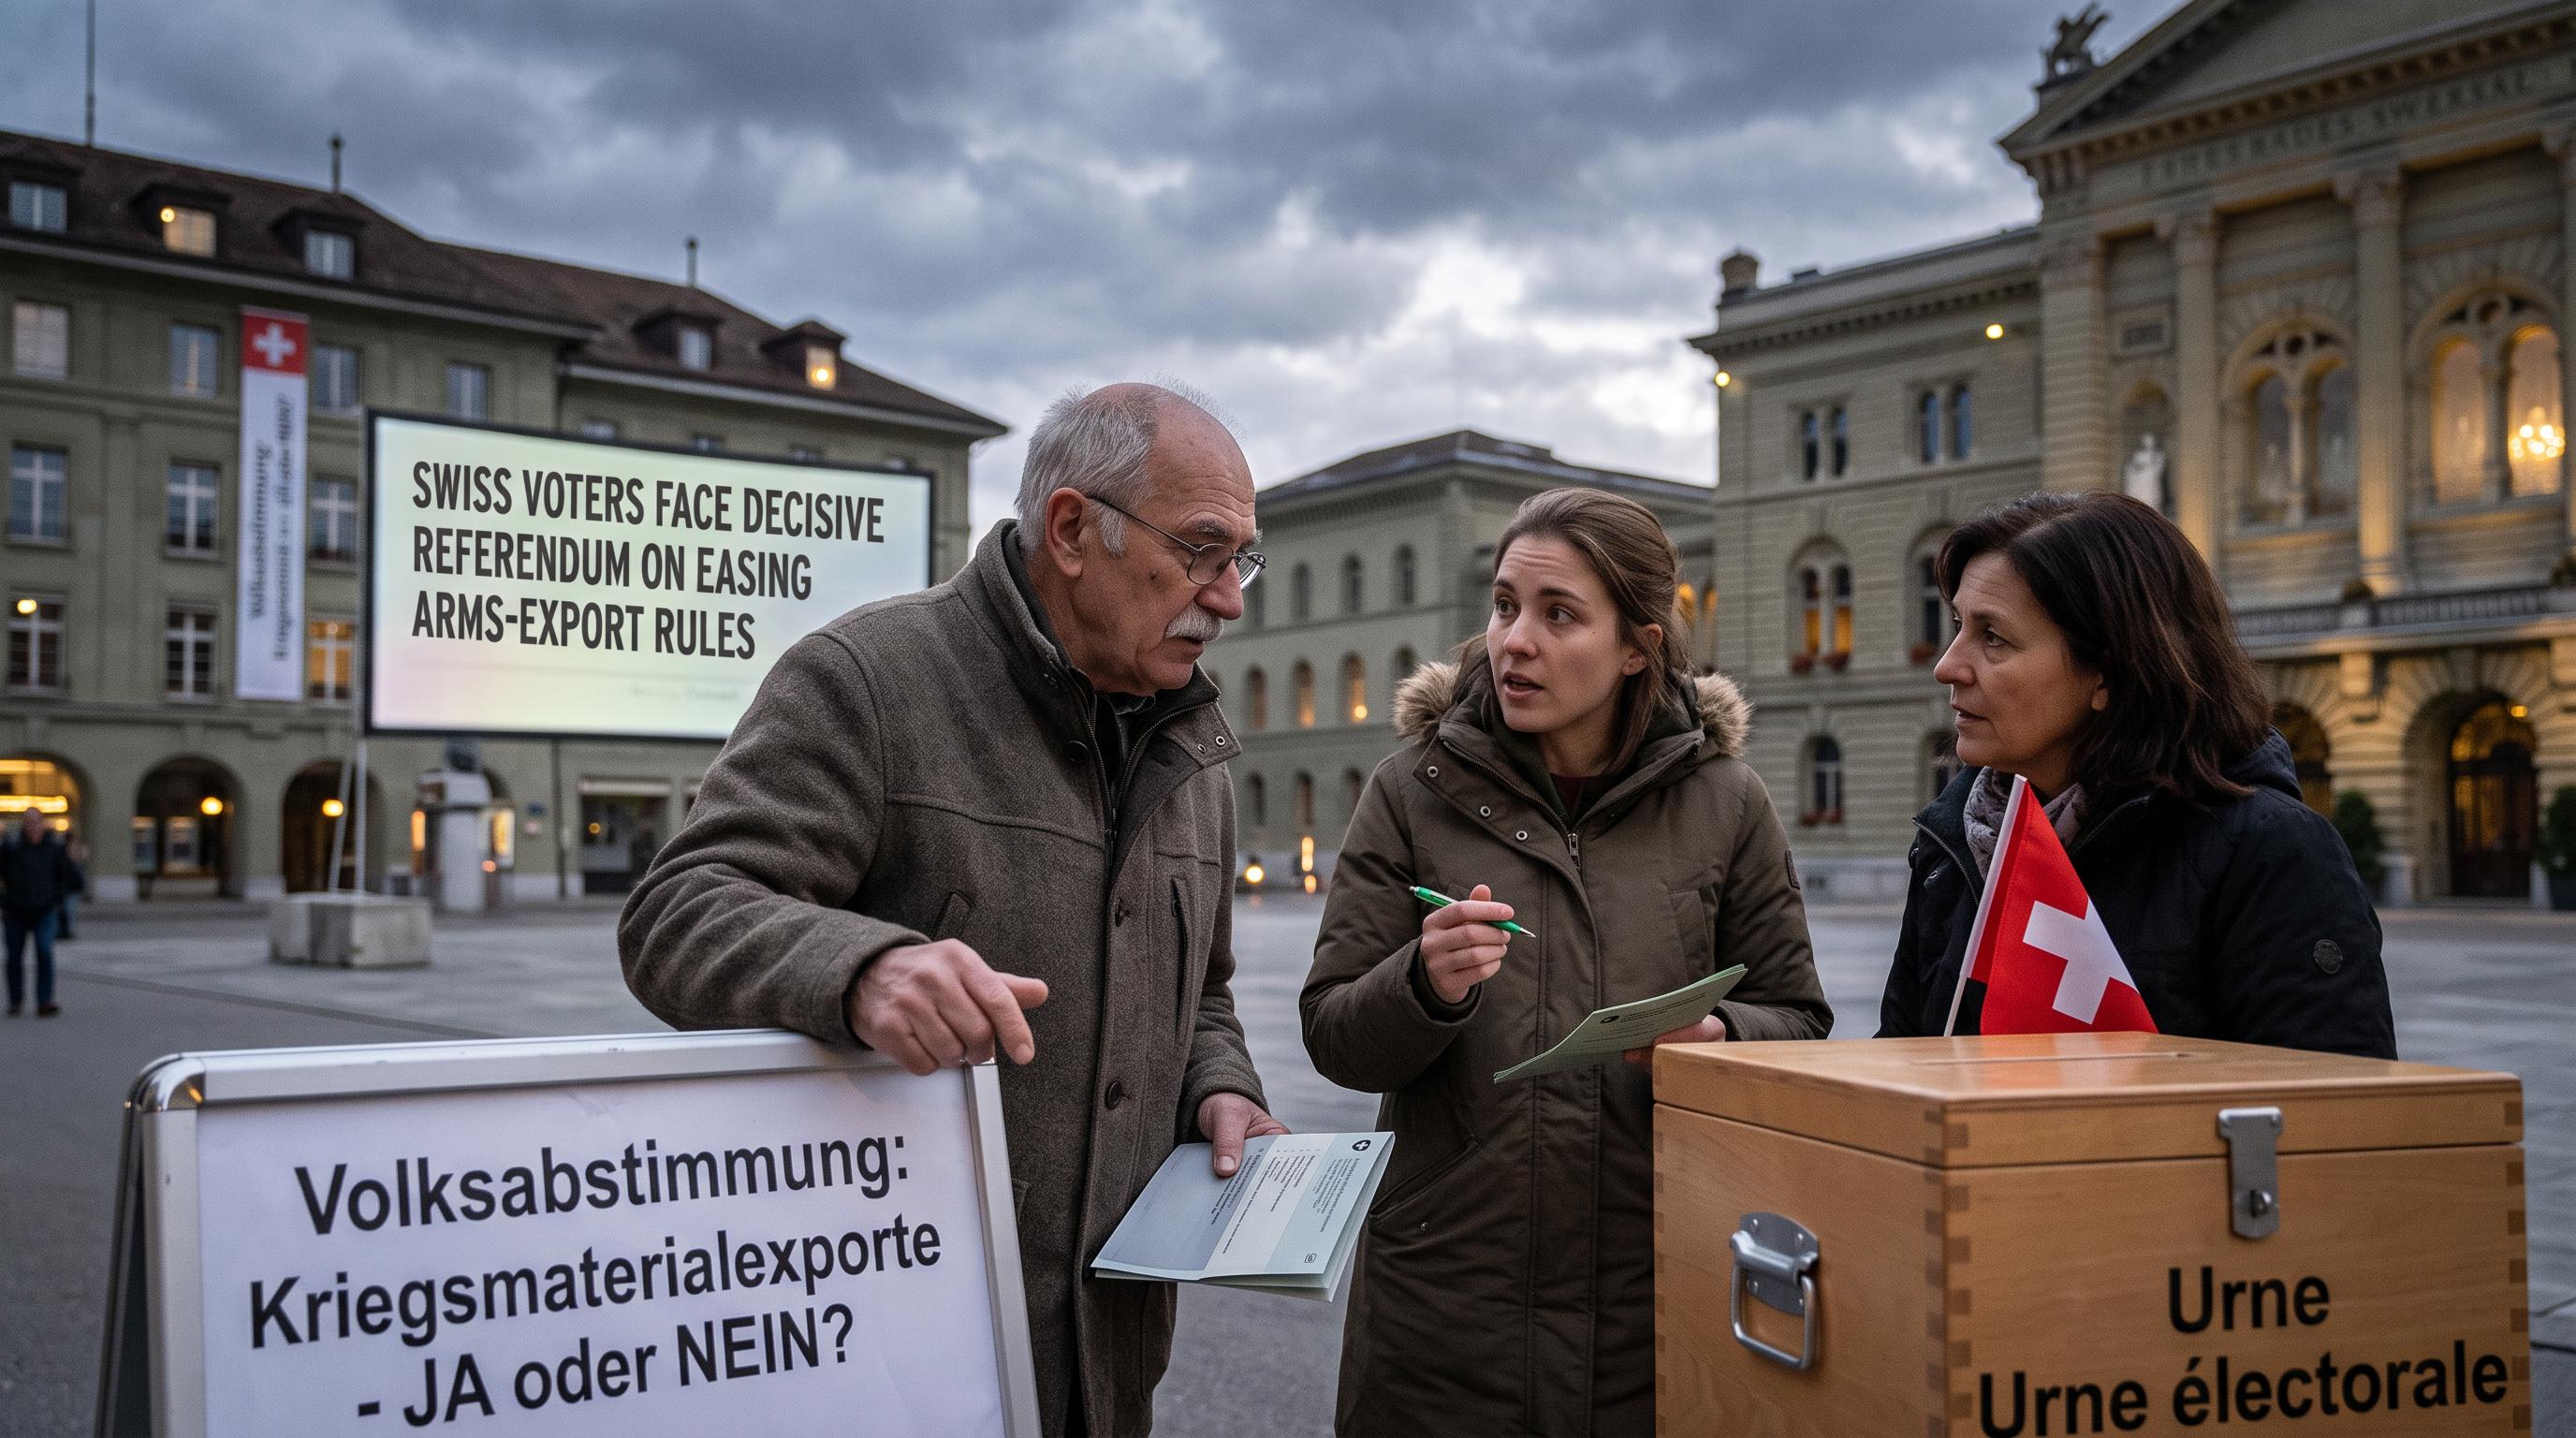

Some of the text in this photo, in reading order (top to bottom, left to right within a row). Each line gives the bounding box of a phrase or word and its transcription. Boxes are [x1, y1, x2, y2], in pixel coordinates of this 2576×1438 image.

[412, 461, 885, 544] SWISS VOTERS FACE DECISIVE
[414, 525, 812, 601] REFERENDUM ON EASING
[411, 590, 755, 660] ARMS-EXPORT RULES
[294, 1135, 910, 1236] Volksabstimmung:
[250, 1212, 942, 1349] Kriegsmaterialexporte
[2168, 1265, 2331, 1335] Urne
[402, 1353, 496, 1428] JA
[514, 1337, 657, 1410] oder
[676, 1303, 855, 1387] NEIN?
[1980, 1339, 2510, 1438] Urne électorale
